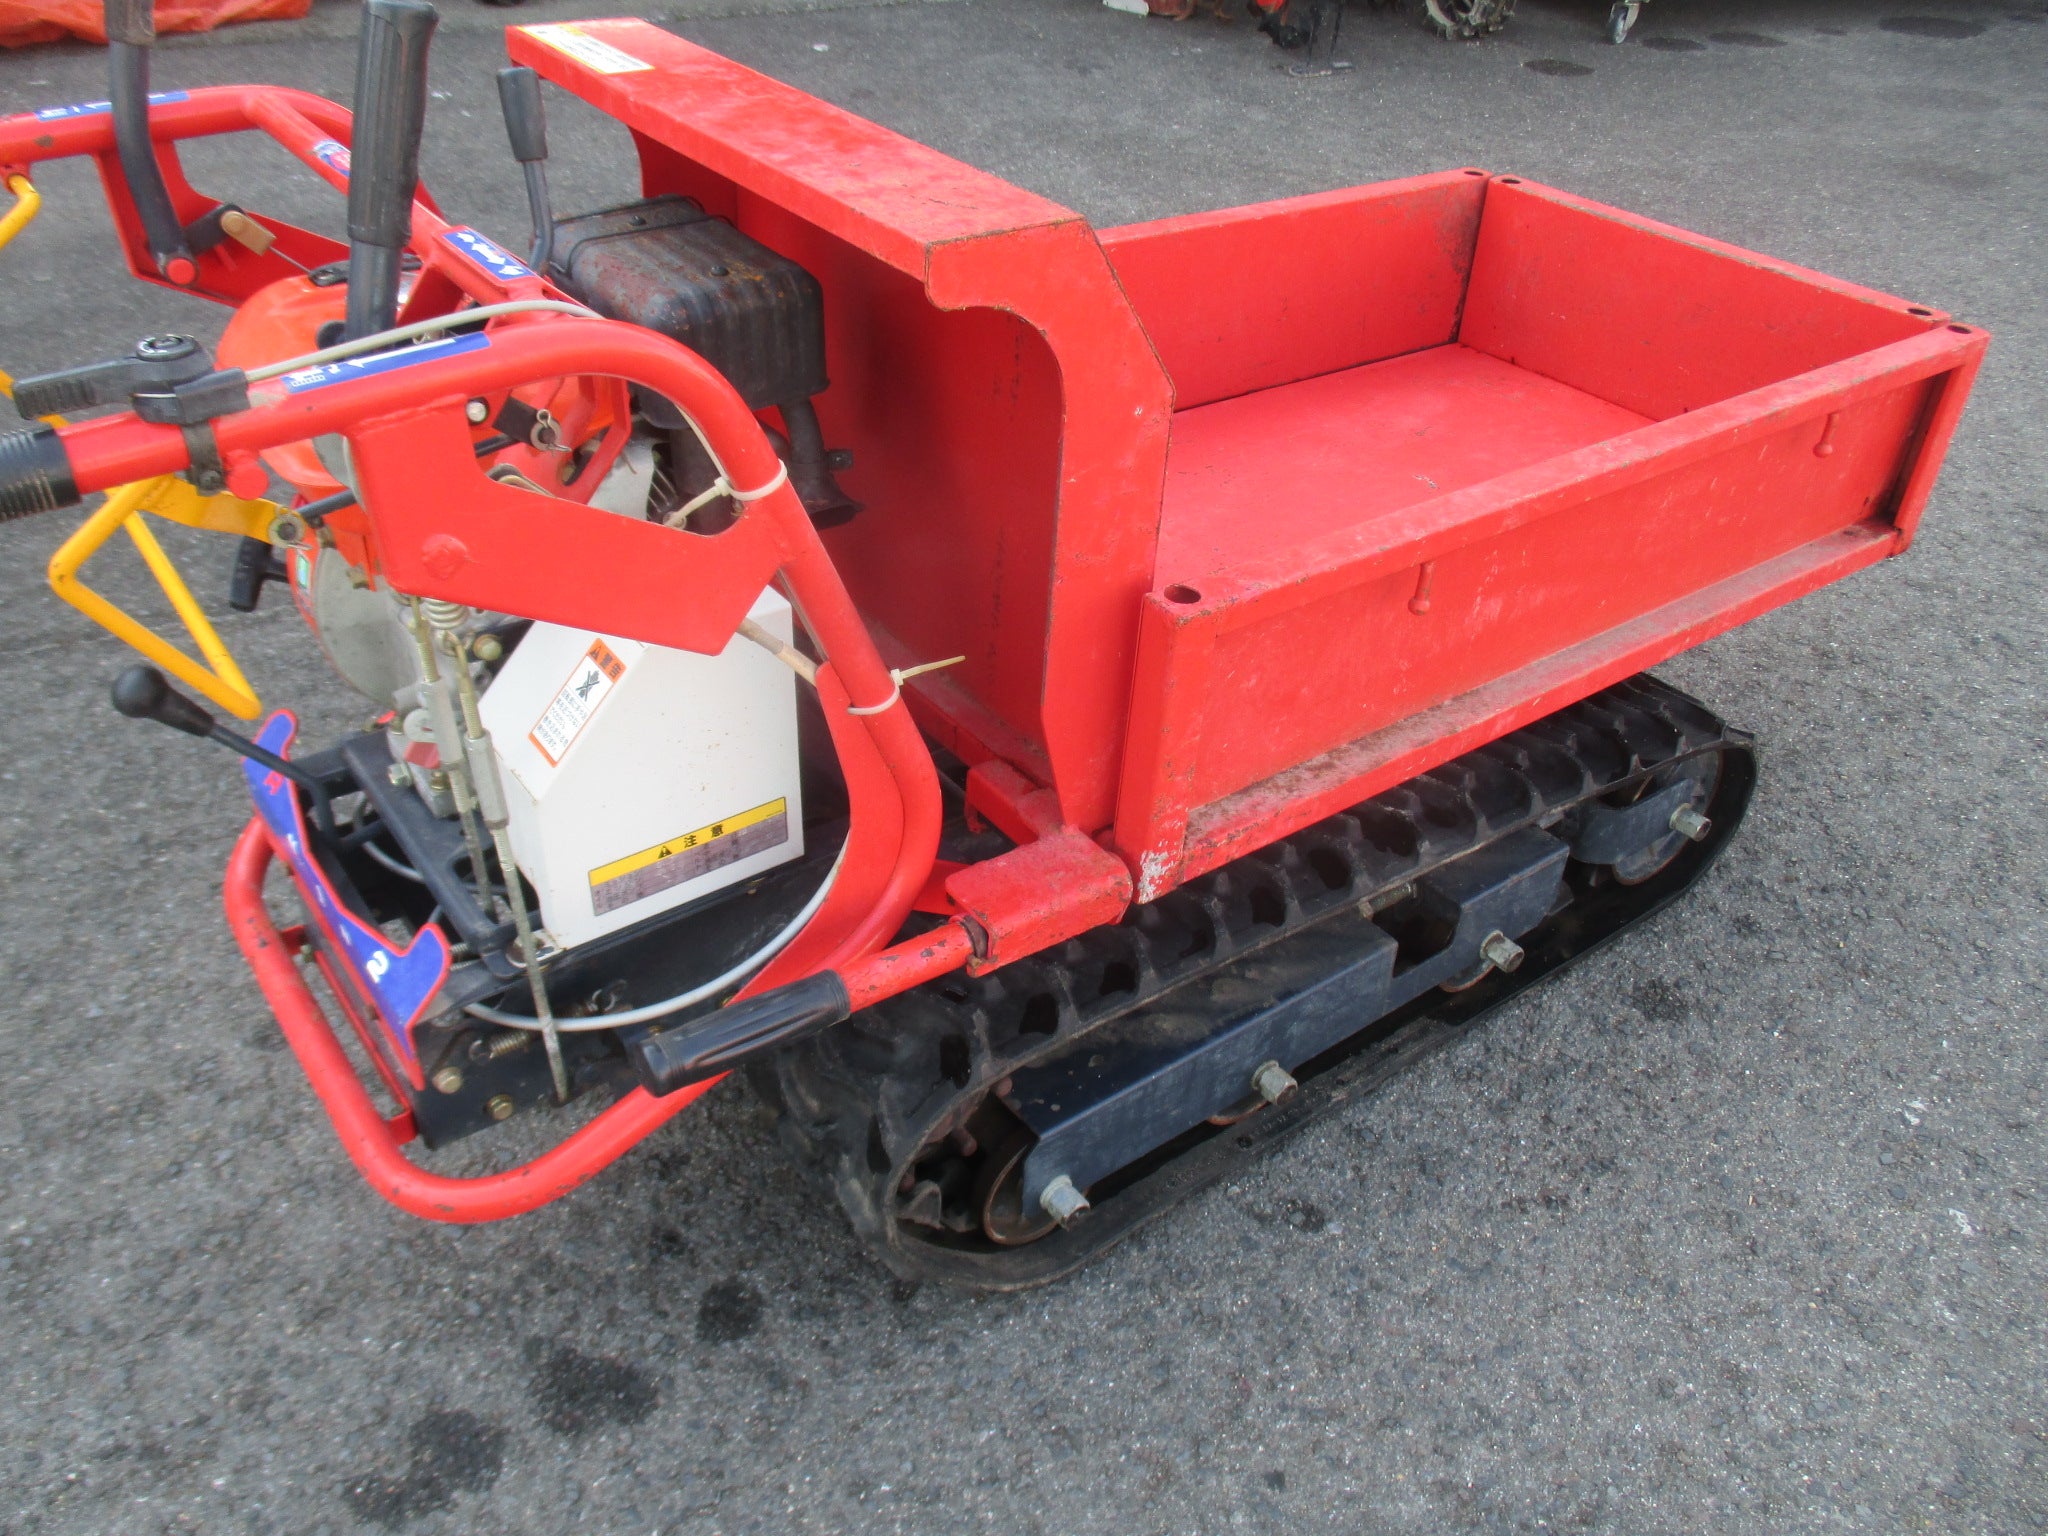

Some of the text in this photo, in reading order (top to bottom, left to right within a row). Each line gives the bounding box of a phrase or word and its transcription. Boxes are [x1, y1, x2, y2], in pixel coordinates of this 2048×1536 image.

[600, 654, 622, 679] 警告
[684, 824, 724, 848] 注意
[367, 951, 388, 984] 2
